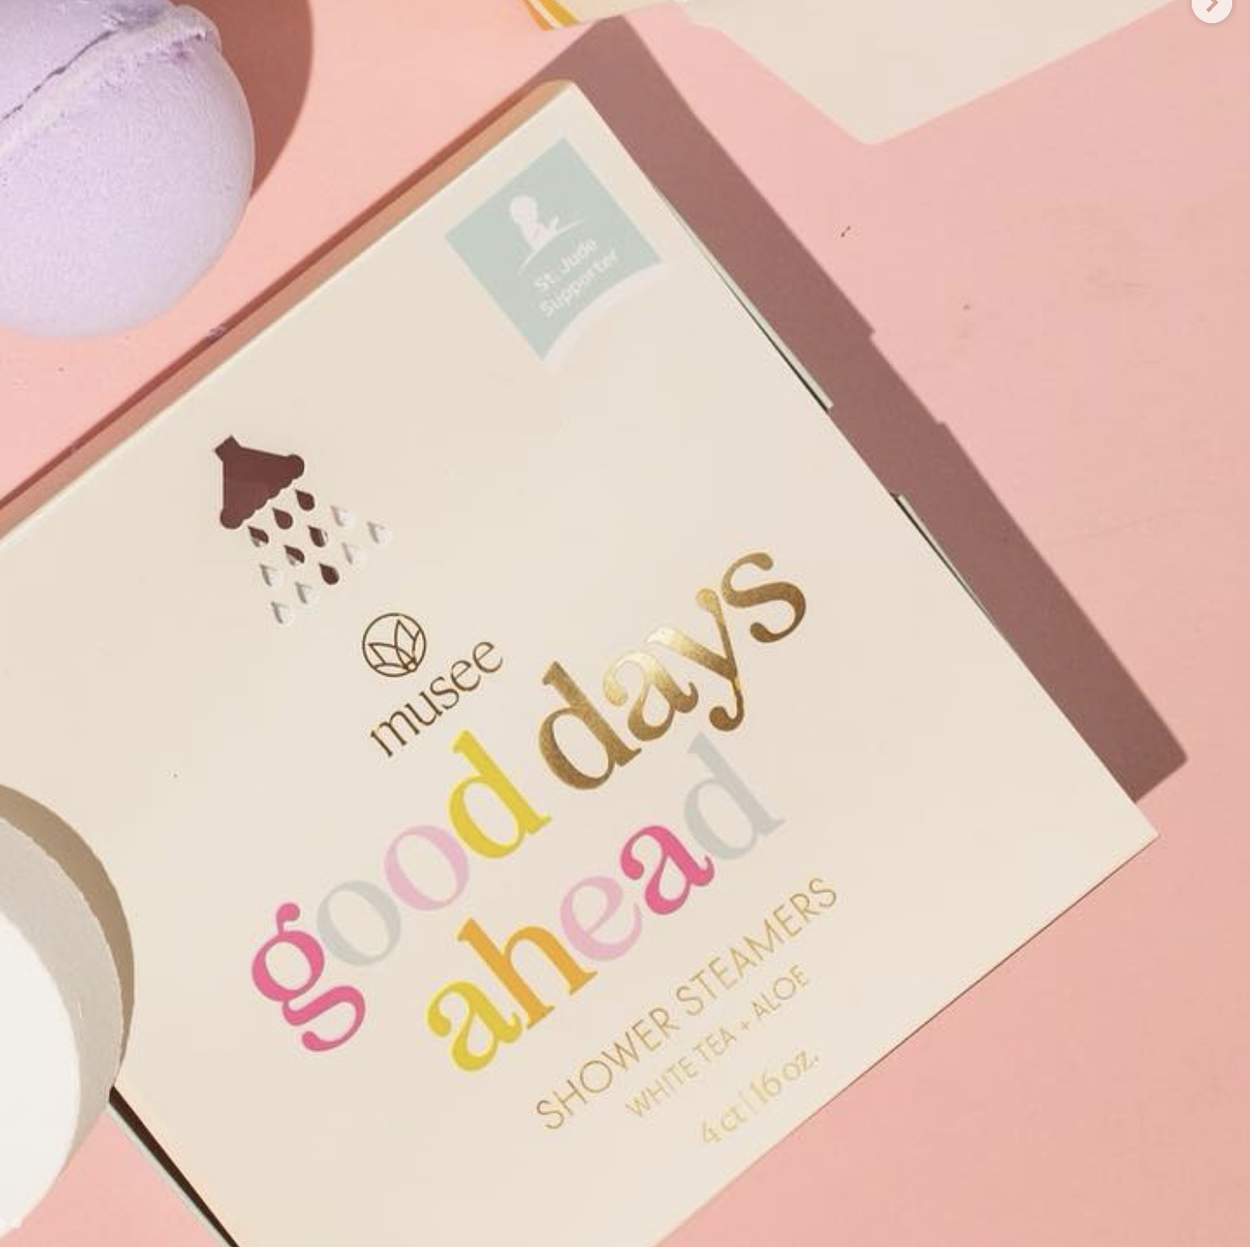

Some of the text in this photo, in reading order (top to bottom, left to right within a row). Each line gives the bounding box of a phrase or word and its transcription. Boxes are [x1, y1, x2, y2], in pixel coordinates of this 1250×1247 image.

[533, 238, 599, 294] St. Jude
[538, 248, 620, 320] Supporter
[369, 640, 504, 757] musee
[250, 551, 807, 1052] good days
[426, 730, 786, 1072] ahead
[535, 877, 838, 1130] SHOWER STEAMERS
[624, 1056, 699, 1118] WHITE
[692, 1026, 738, 1065] TEA
[750, 964, 810, 1022] ALOE
[700, 1120, 722, 1144] 4
[748, 1069, 784, 1106] 16
